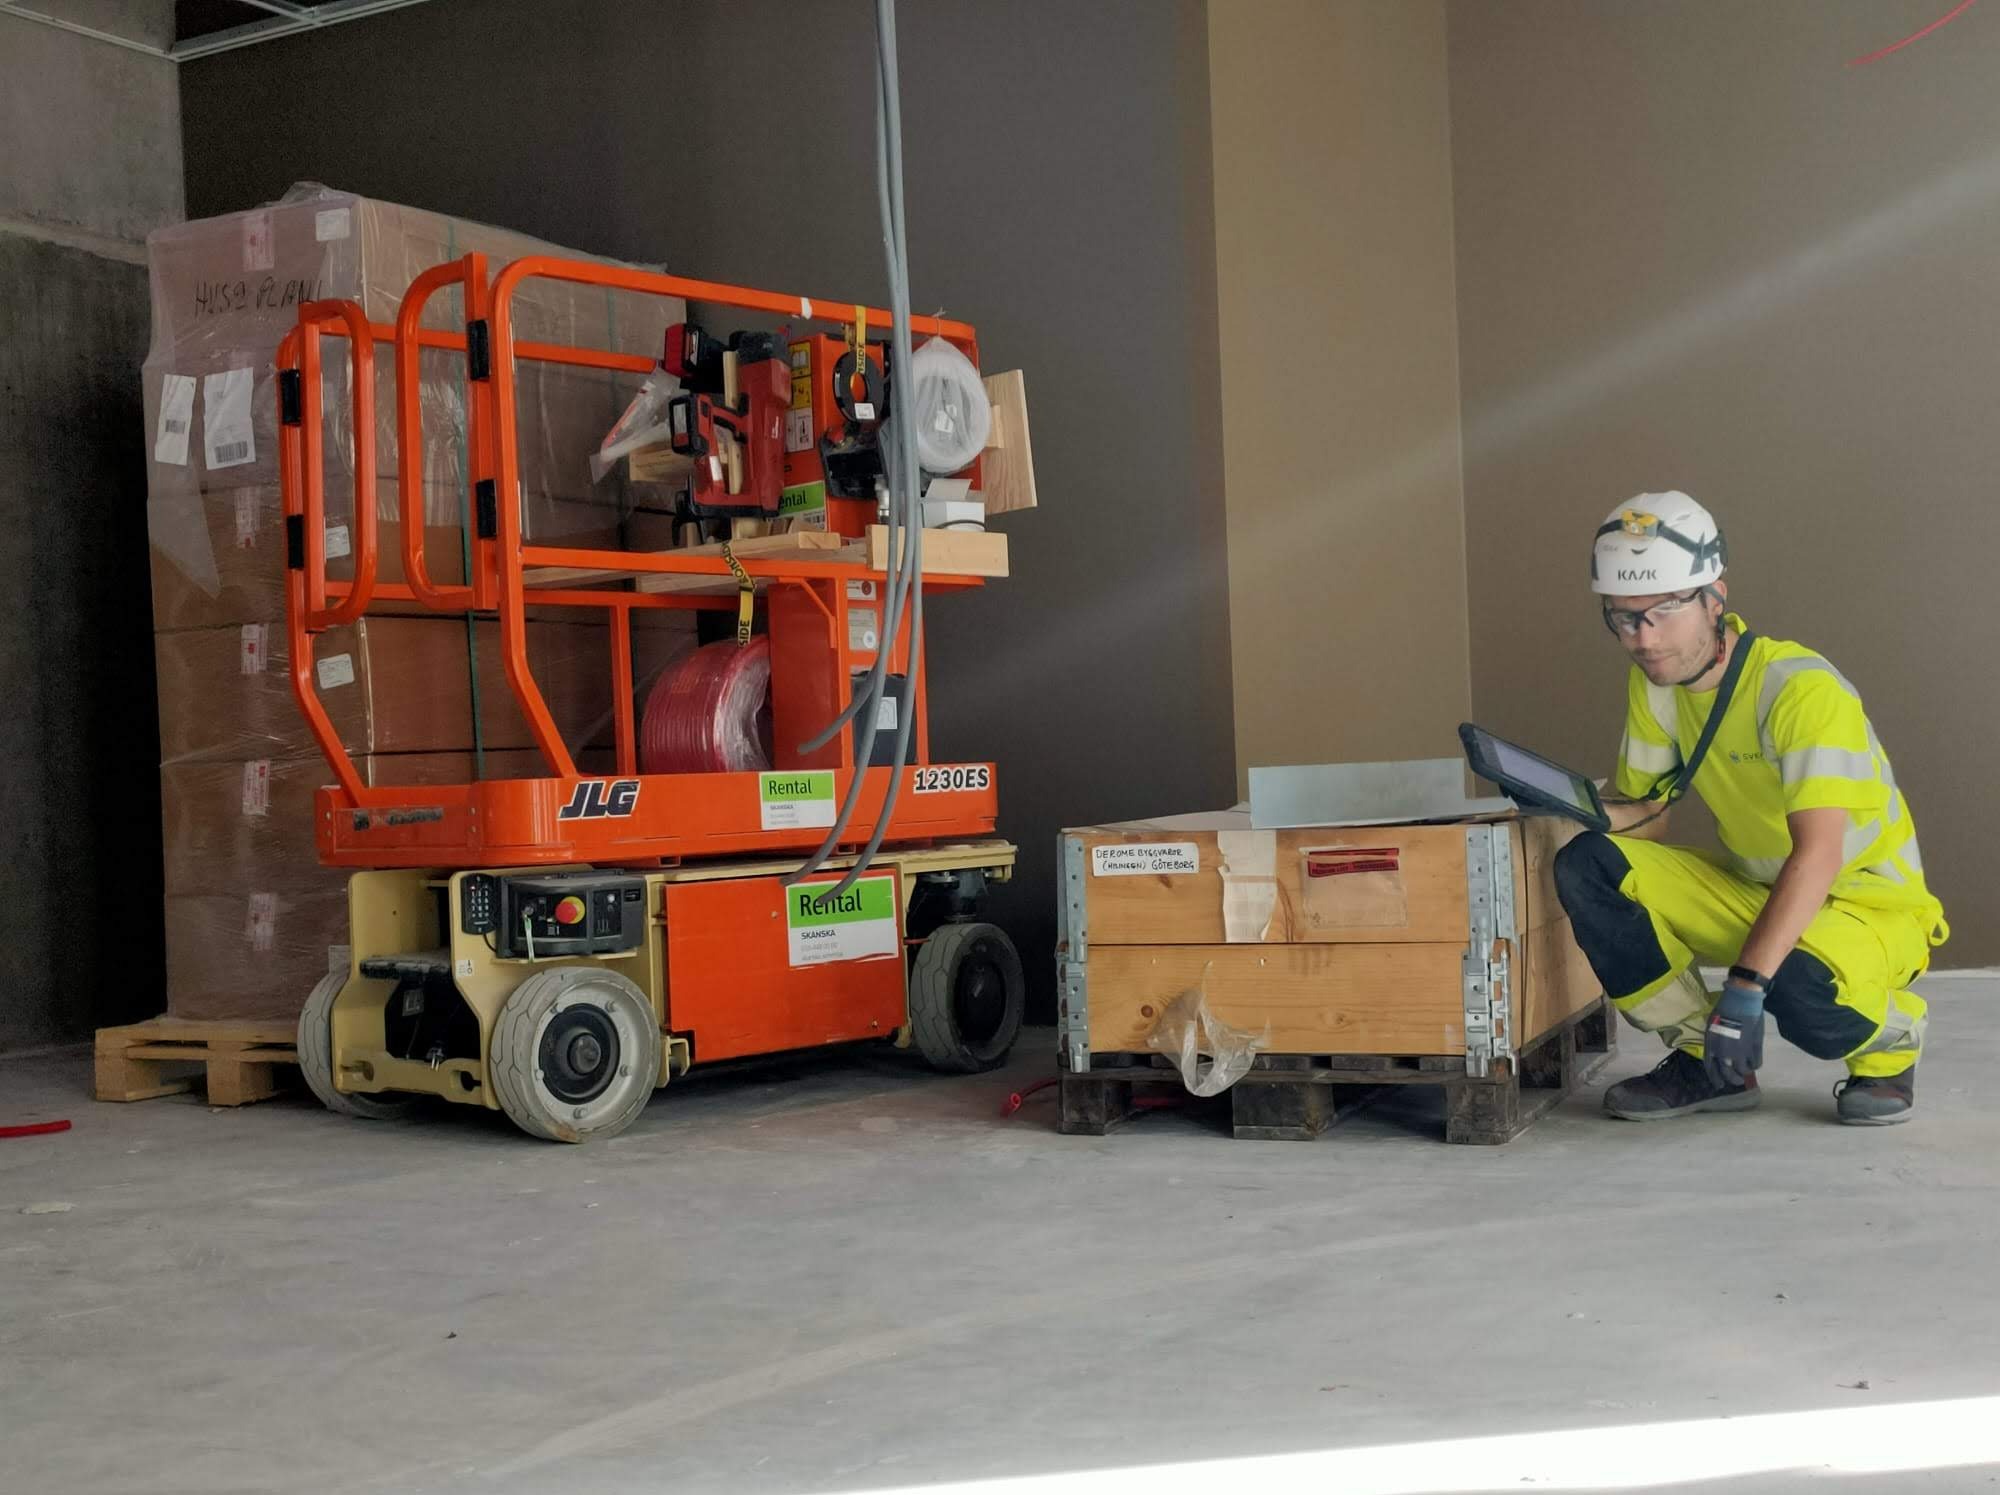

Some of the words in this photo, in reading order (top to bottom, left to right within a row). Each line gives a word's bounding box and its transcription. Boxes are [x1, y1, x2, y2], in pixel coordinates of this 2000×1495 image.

[779, 490, 807, 508] ental
[1617, 568, 1657, 581] KASK
[768, 778, 813, 796] Rental
[915, 767, 989, 791] 1230ES
[558, 781, 640, 819] JLG
[1095, 848, 1136, 859] DEROME
[799, 887, 863, 917] Rental
[801, 929, 837, 940] SKANSKA
